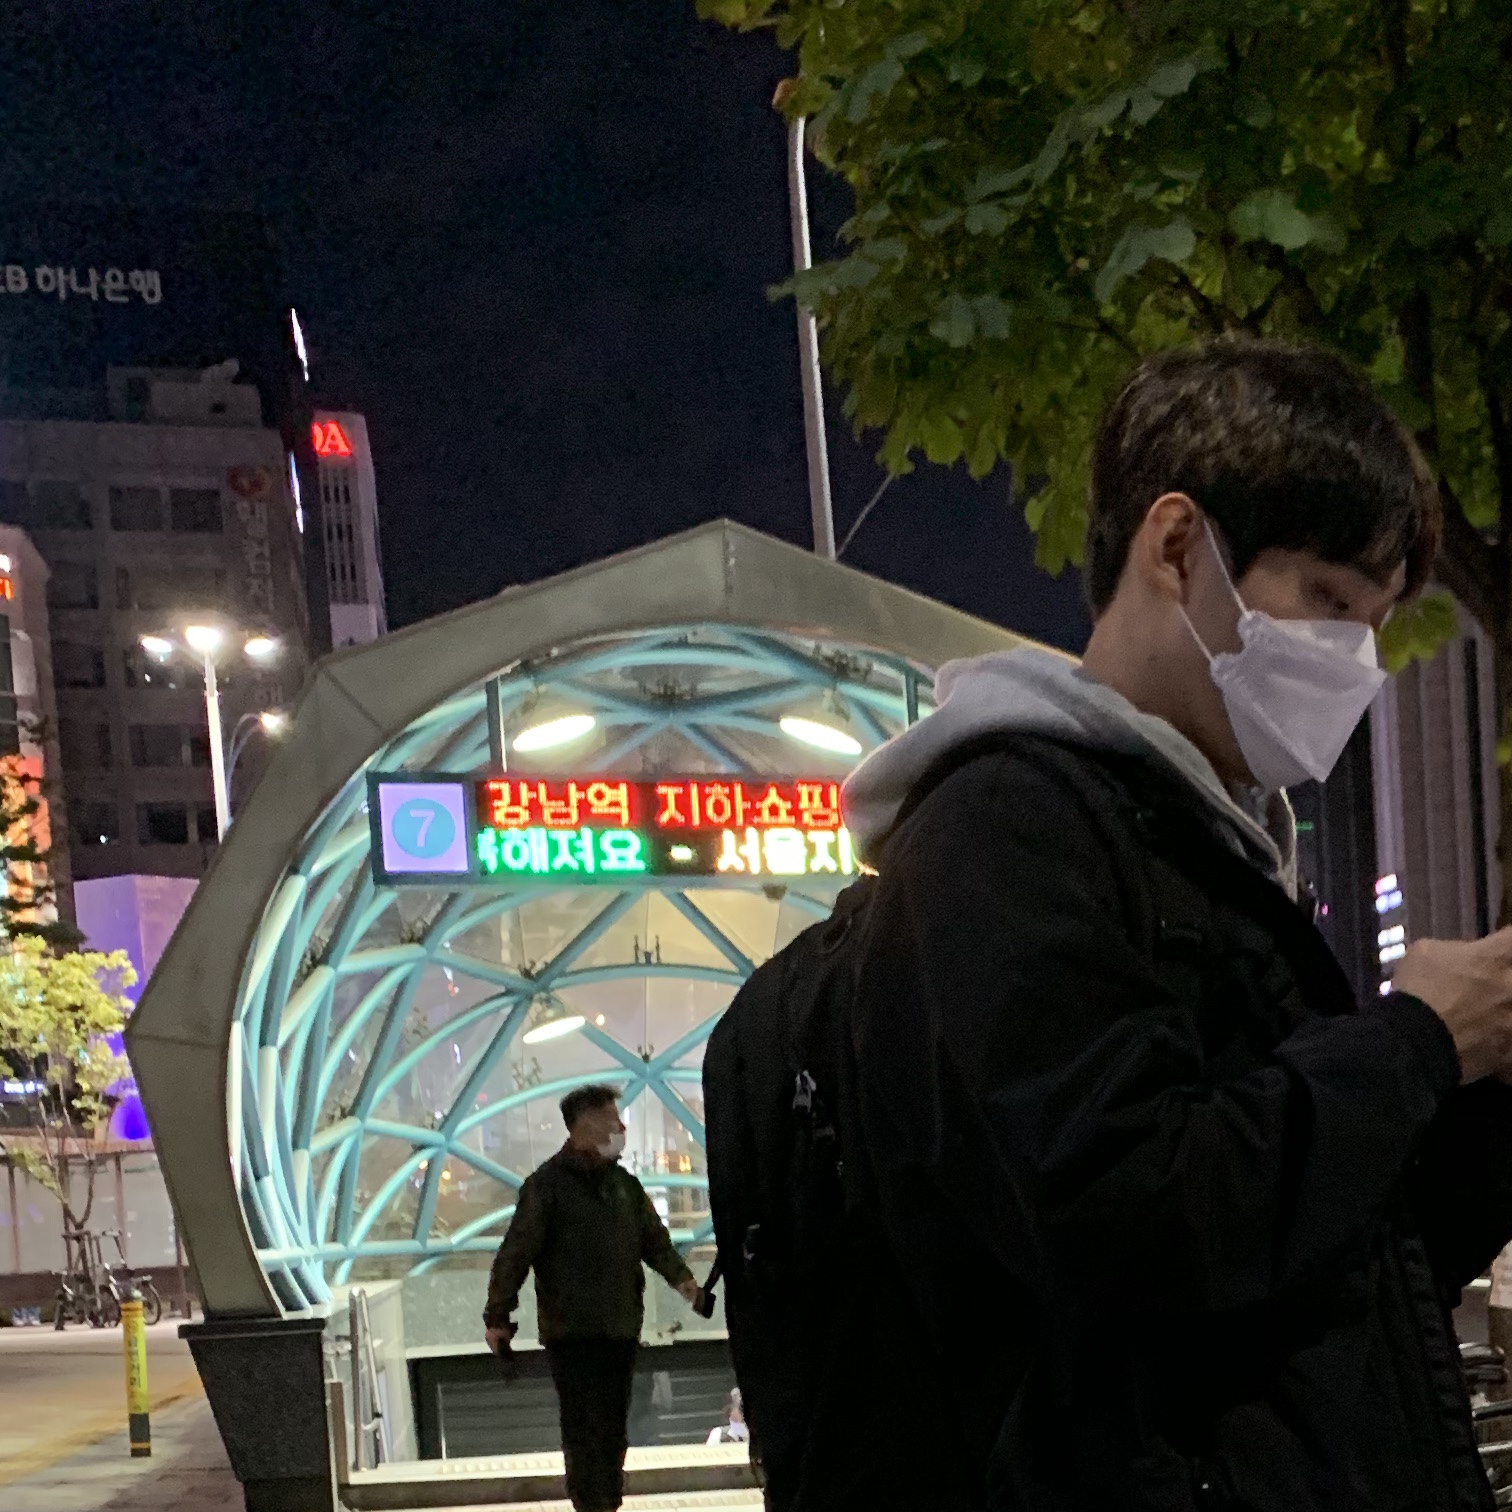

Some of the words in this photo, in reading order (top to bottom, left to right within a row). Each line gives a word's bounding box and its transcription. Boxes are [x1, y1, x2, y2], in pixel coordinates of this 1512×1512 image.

[35, 263, 163, 304] 하나은행
[487, 781, 630, 827] 강남역
[655, 782, 839, 827] 지하쇼핑
[409, 809, 435, 848] 7
